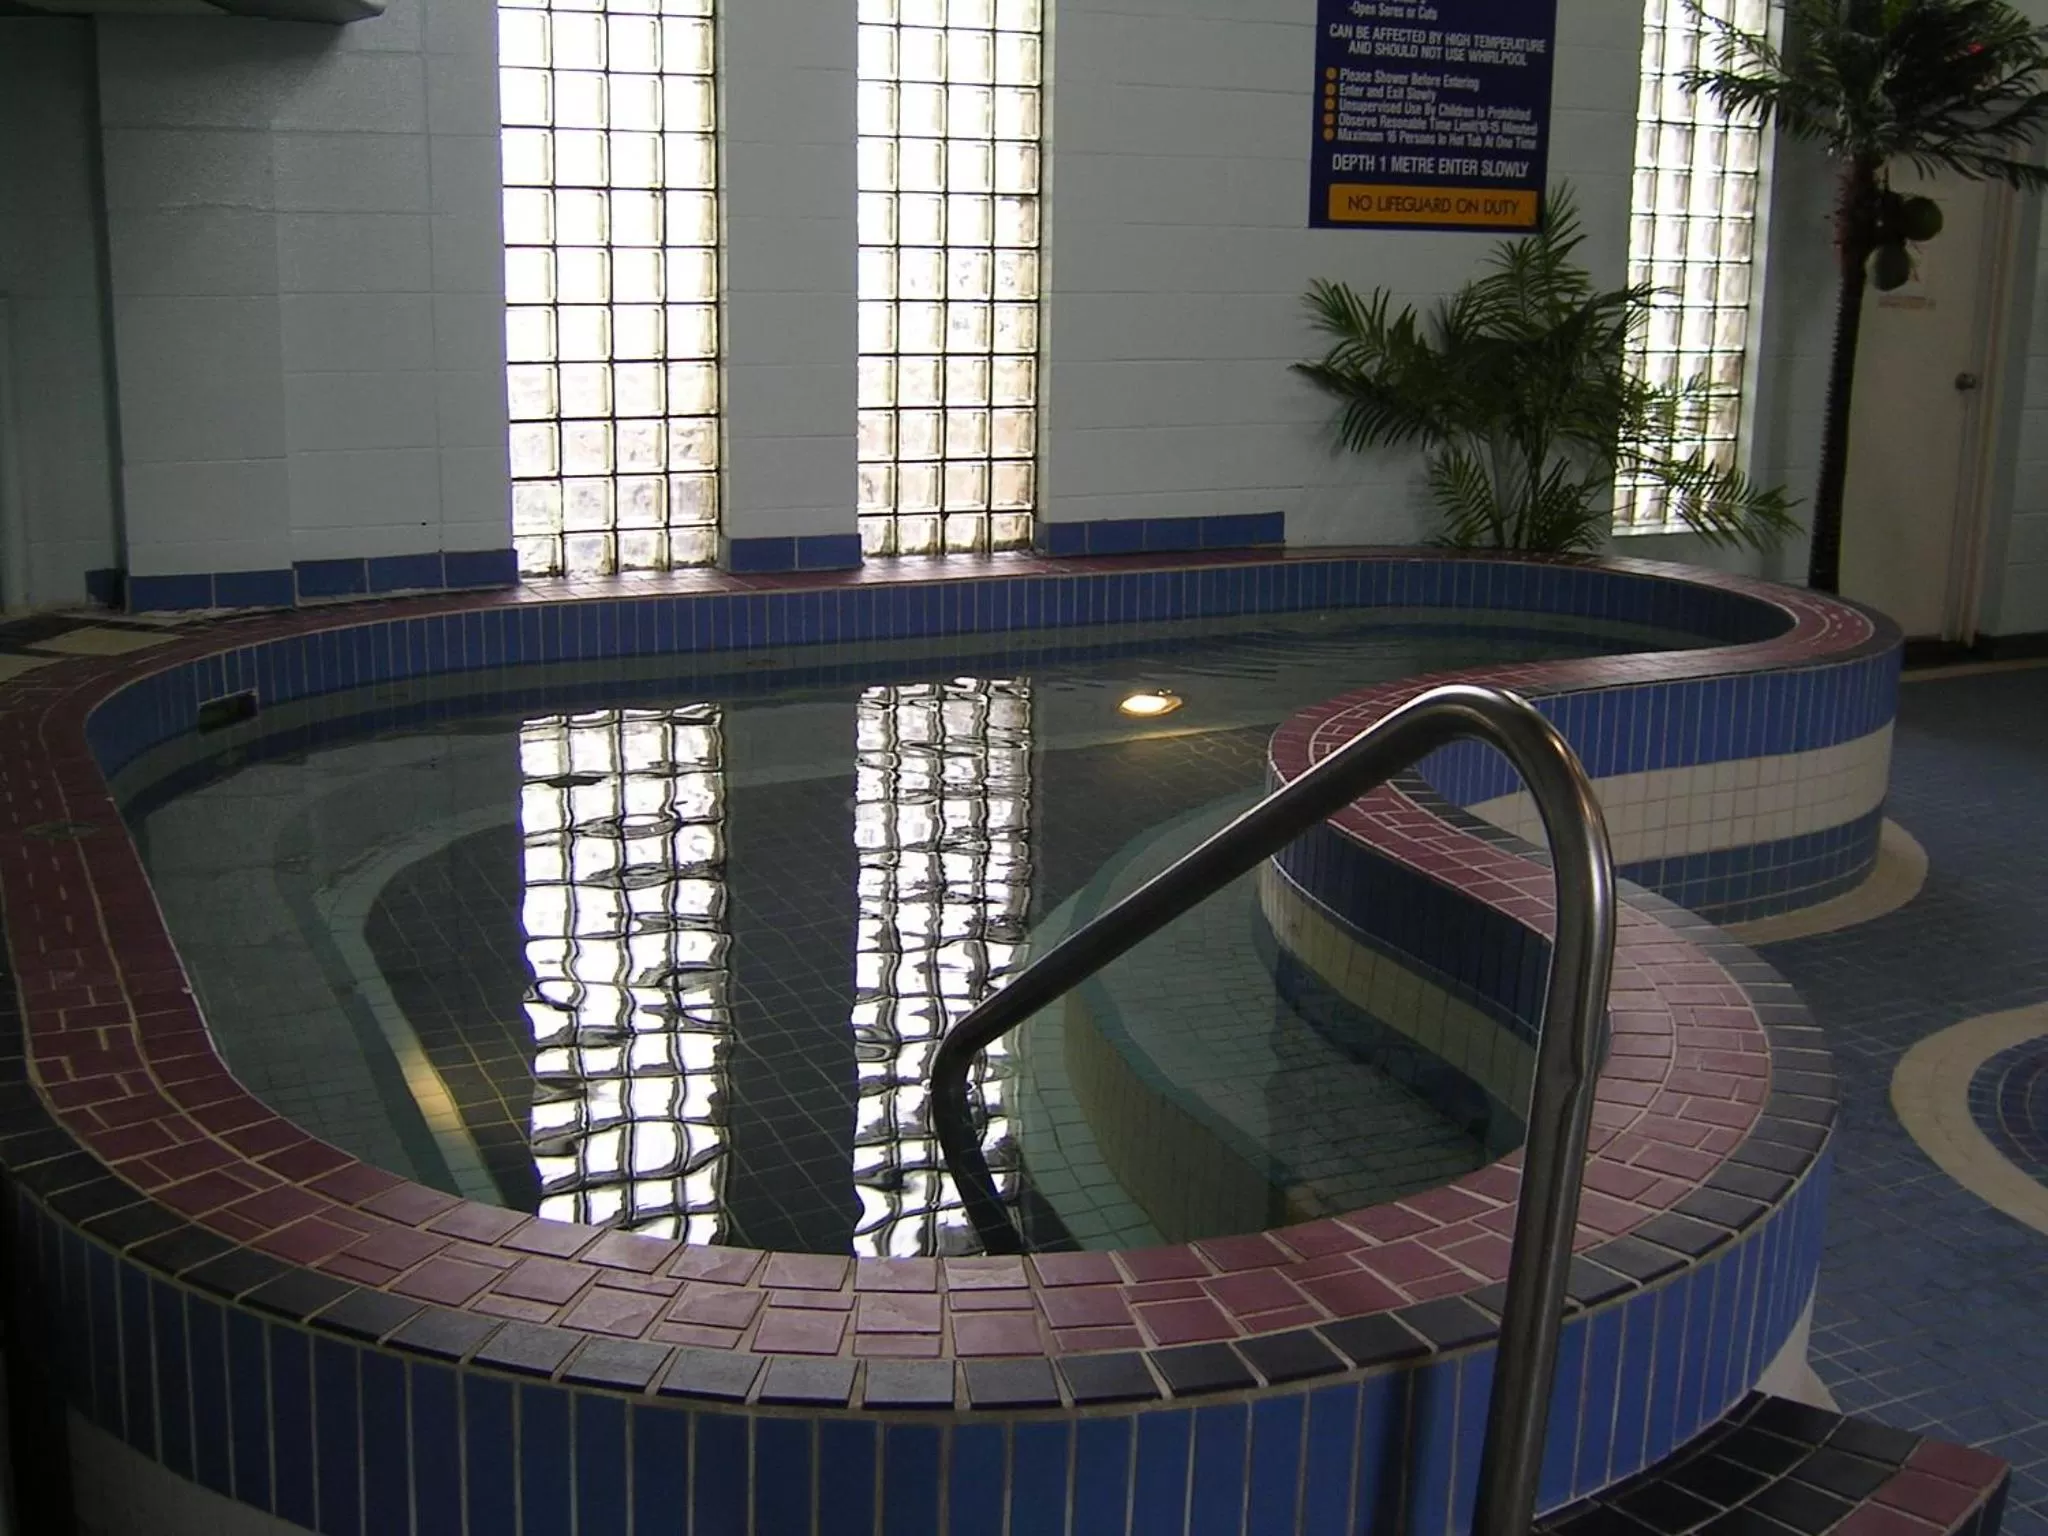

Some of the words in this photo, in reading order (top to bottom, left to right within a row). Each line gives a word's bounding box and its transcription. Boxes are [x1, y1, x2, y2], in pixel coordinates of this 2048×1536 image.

[1378, 2, 1404, 18] Sores
[1406, 7, 1416, 19] or
[1418, 6, 1438, 20] Cuts
[1329, 23, 1353, 38] CAN
[1355, 25, 1370, 39] BE
[1372, 27, 1426, 44] AFFECTED
[1428, 31, 1443, 45] BY
[1445, 32, 1471, 47] HIGH
[1474, 34, 1547, 53] TEMPERATURE
[1348, 40, 1372, 55] AND
[1375, 42, 1418, 58] SHOULD
[1420, 45, 1444, 60] NOT
[1445, 47, 1465, 62] USE
[1468, 50, 1528, 66] WHIRLPOOL
[1339, 67, 1372, 83] Please
[1374, 69, 1409, 84] Shower
[1411, 72, 1441, 87] Before
[1443, 74, 1480, 92] Entering
[1339, 83, 1364, 97] Enter
[1367, 85, 1384, 98] and
[1386, 86, 1404, 99] Exit
[1406, 87, 1437, 103] Slowly
[1339, 97, 1402, 114] Unsupervised
[1404, 101, 1422, 115] Use
[1424, 103, 1436, 117] By
[1438, 103, 1475, 118] Children
[1487, 107, 1532, 121] Prohibited
[1338, 112, 1377, 128] Observe
[1430, 116, 1452, 131] Time
[1337, 128, 1384, 142] Maximum
[1399, 131, 1436, 145] Persons
[1448, 133, 1465, 146] Hot
[1467, 134, 1482, 147] Tub
[1484, 135, 1494, 148] At
[1496, 135, 1513, 149] One
[1516, 136, 1537, 149] Time
[1332, 154, 1375, 172] DEPTH
[1380, 156, 1386, 172] 1
[1390, 157, 1434, 174] METRE
[1438, 159, 1478, 176] ENTER
[1481, 160, 1529, 178] SLOWLY
[1348, 195, 1372, 211] NO
[1377, 195, 1450, 214] LIFEGUARD
[1456, 197, 1479, 214] ON
[1484, 198, 1519, 216] DUTY
